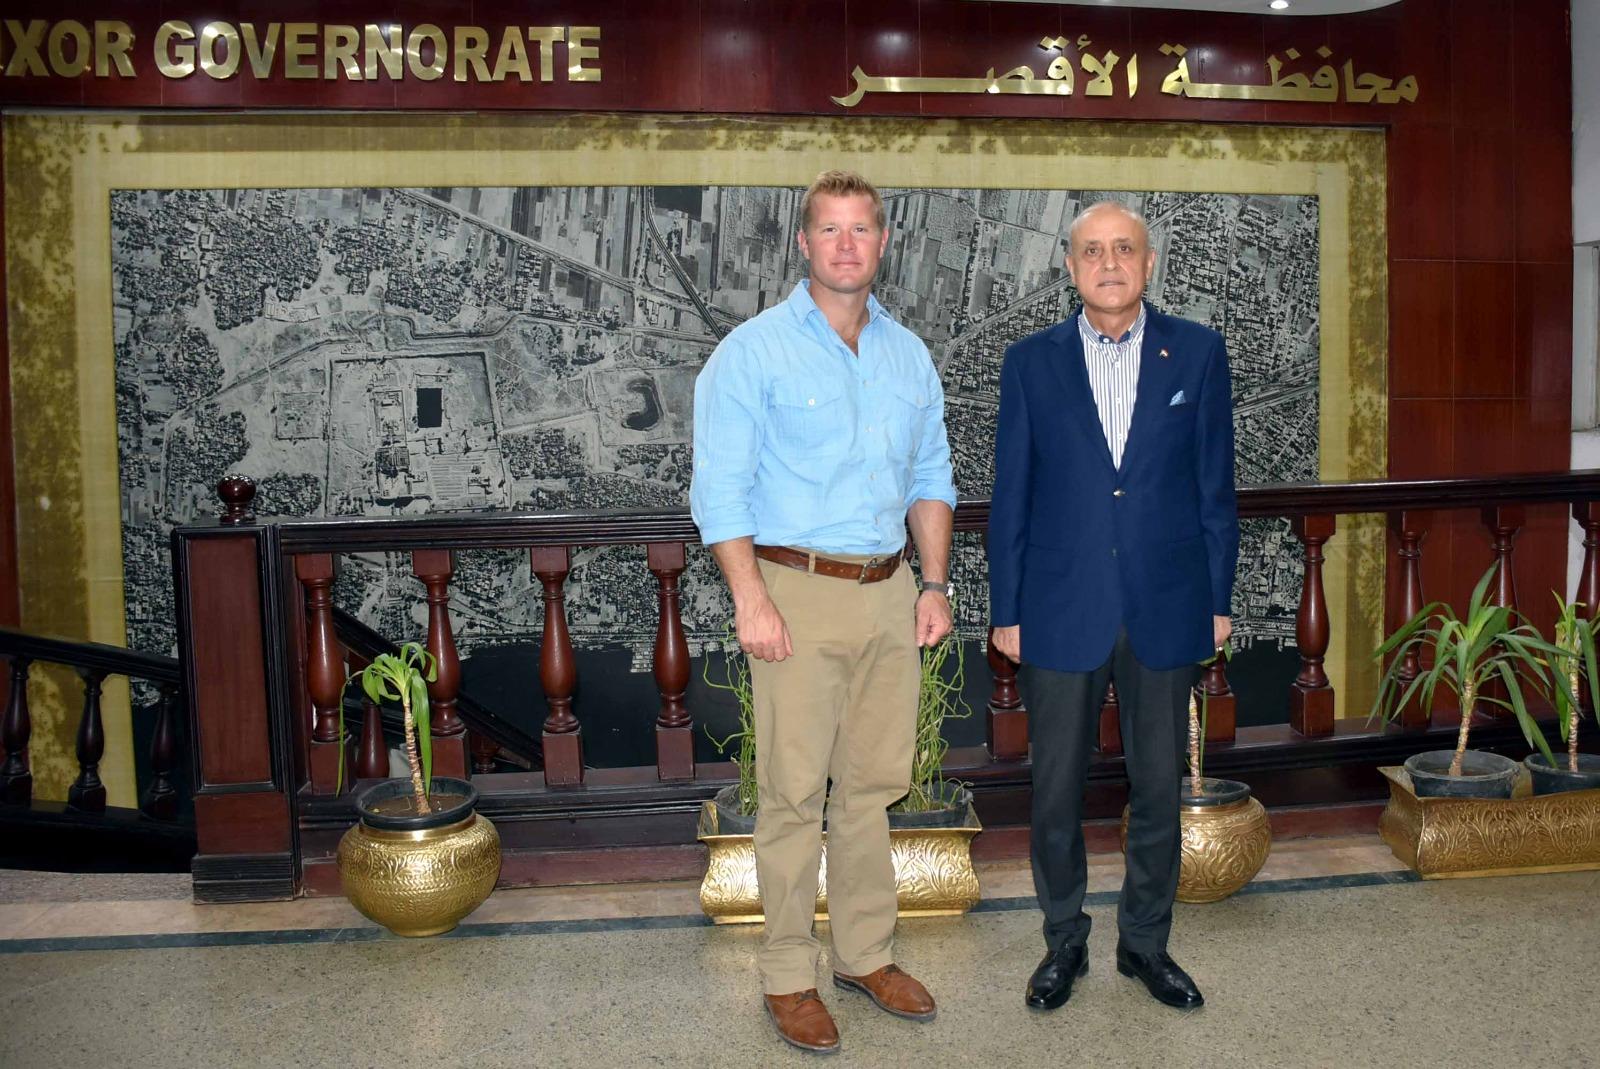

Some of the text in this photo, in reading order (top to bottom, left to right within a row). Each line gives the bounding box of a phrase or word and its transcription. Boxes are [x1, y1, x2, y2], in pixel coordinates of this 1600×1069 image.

[0, 19, 602, 82] XOR GOVERNORATE
[831, 34, 1419, 107] محافظة الأقصر
